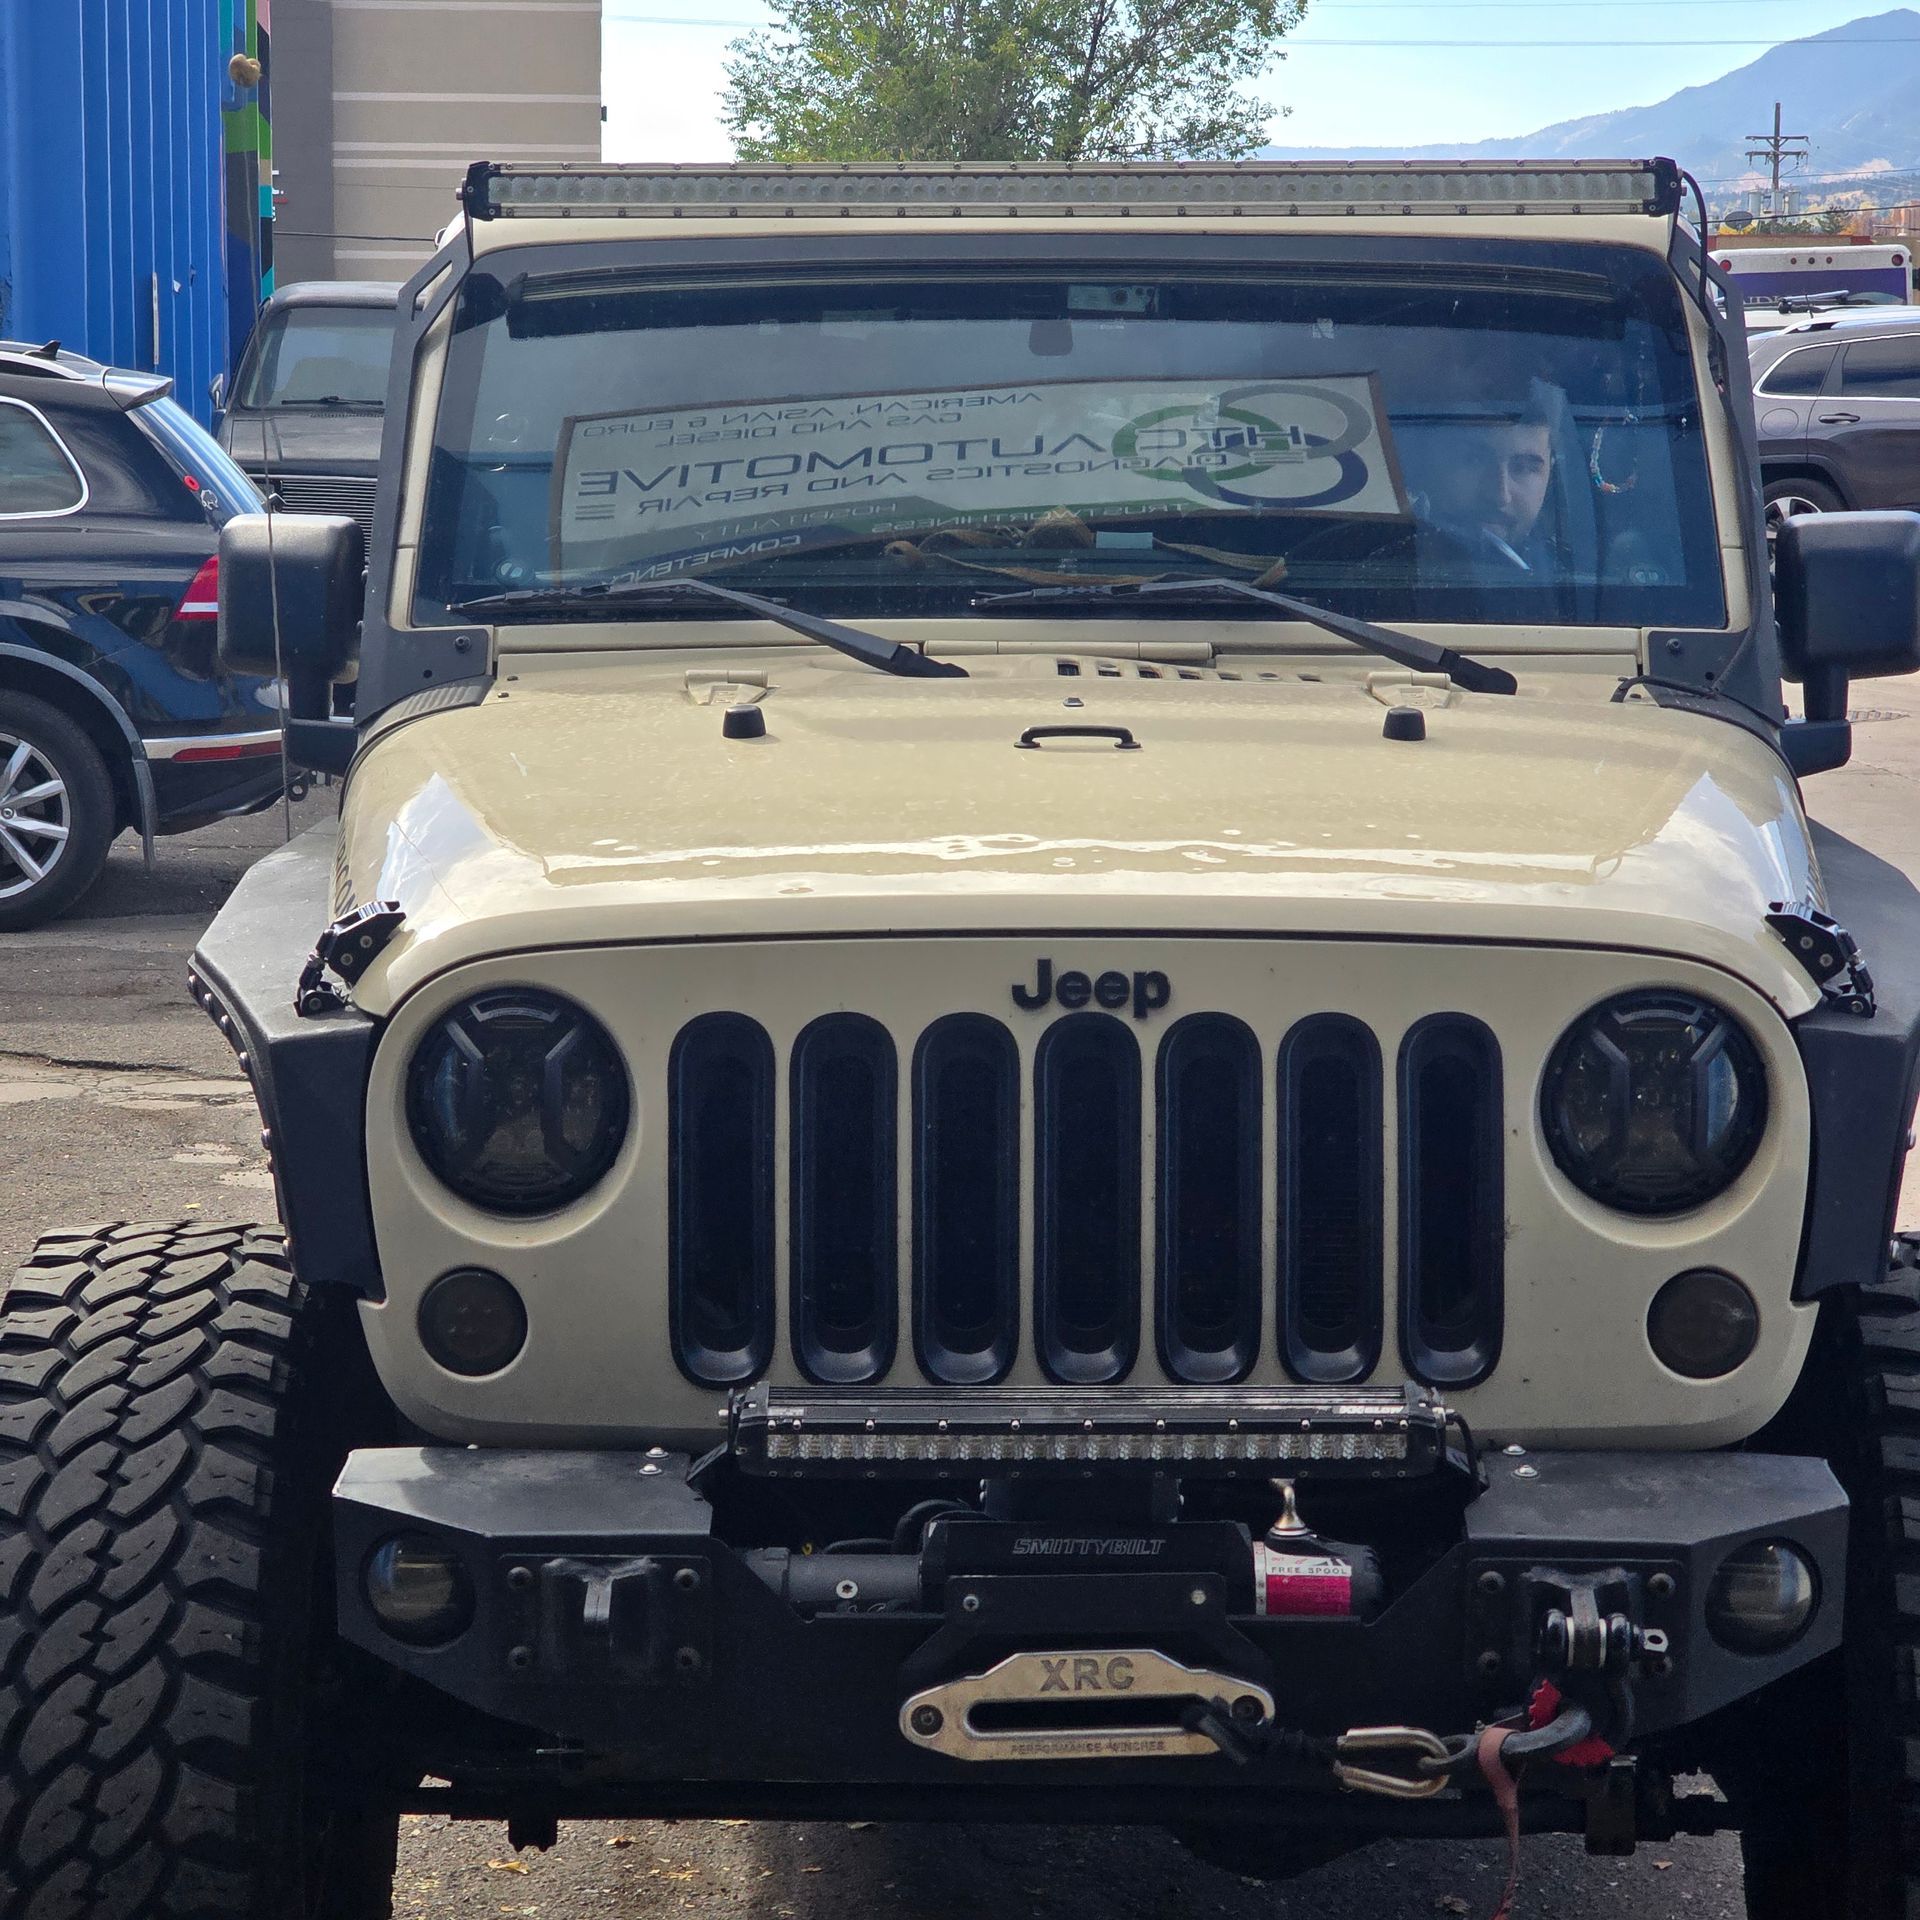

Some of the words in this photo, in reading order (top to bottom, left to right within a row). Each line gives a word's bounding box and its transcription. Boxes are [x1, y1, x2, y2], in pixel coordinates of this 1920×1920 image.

[1011, 957, 1171, 1019] Jeep
[1012, 1538, 1166, 1555] SMITTYBILT
[1271, 1566, 1300, 1574] FREE
[1307, 1566, 1347, 1575] SPOOL
[1040, 1656, 1135, 1692] XRC
